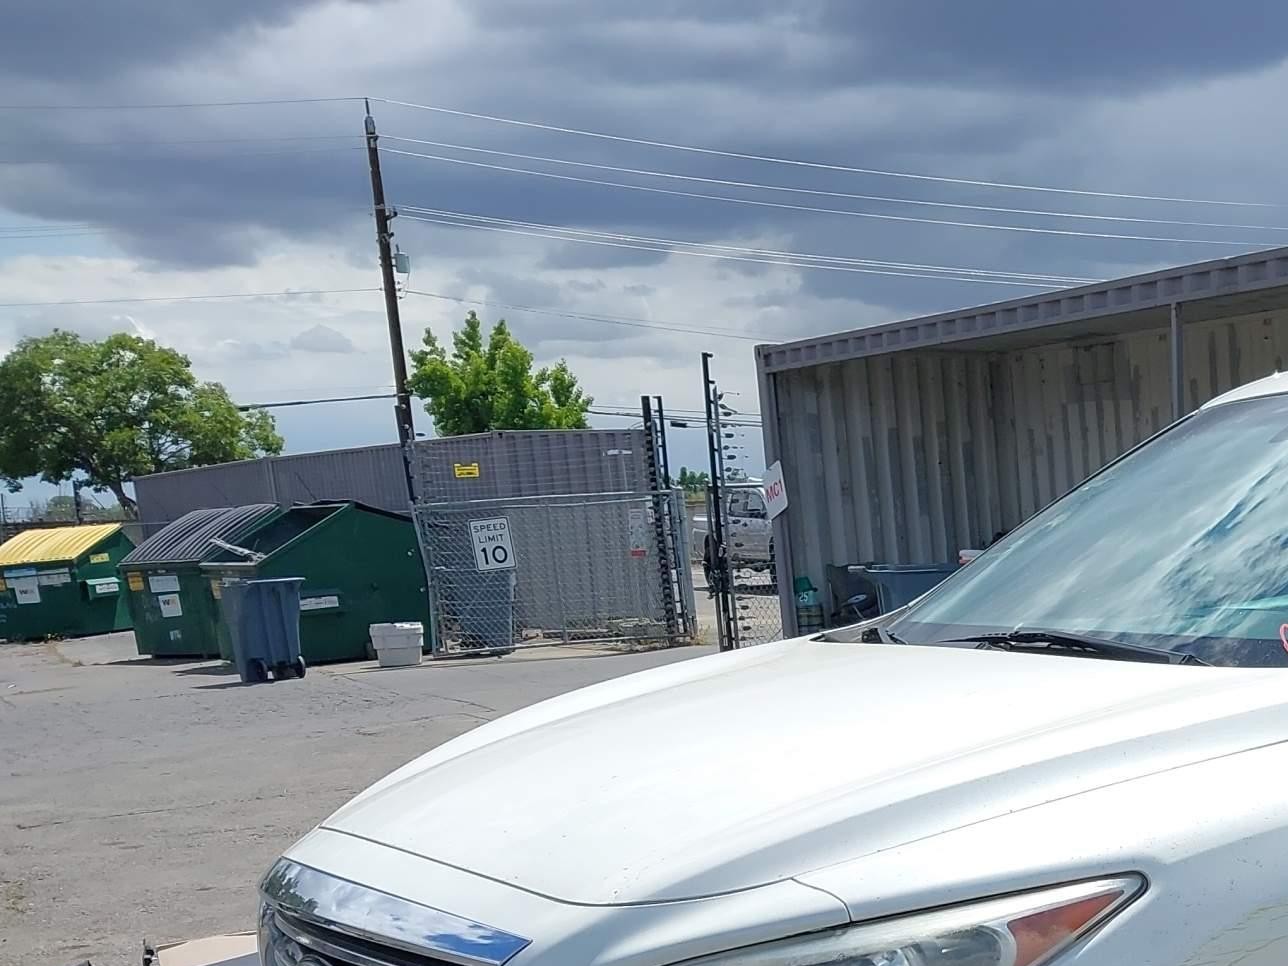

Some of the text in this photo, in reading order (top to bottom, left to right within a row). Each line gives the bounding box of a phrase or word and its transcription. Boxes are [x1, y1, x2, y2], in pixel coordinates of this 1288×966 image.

[473, 522, 506, 533] SPEED
[478, 533, 504, 544] LIMIT
[480, 545, 508, 566] 10
